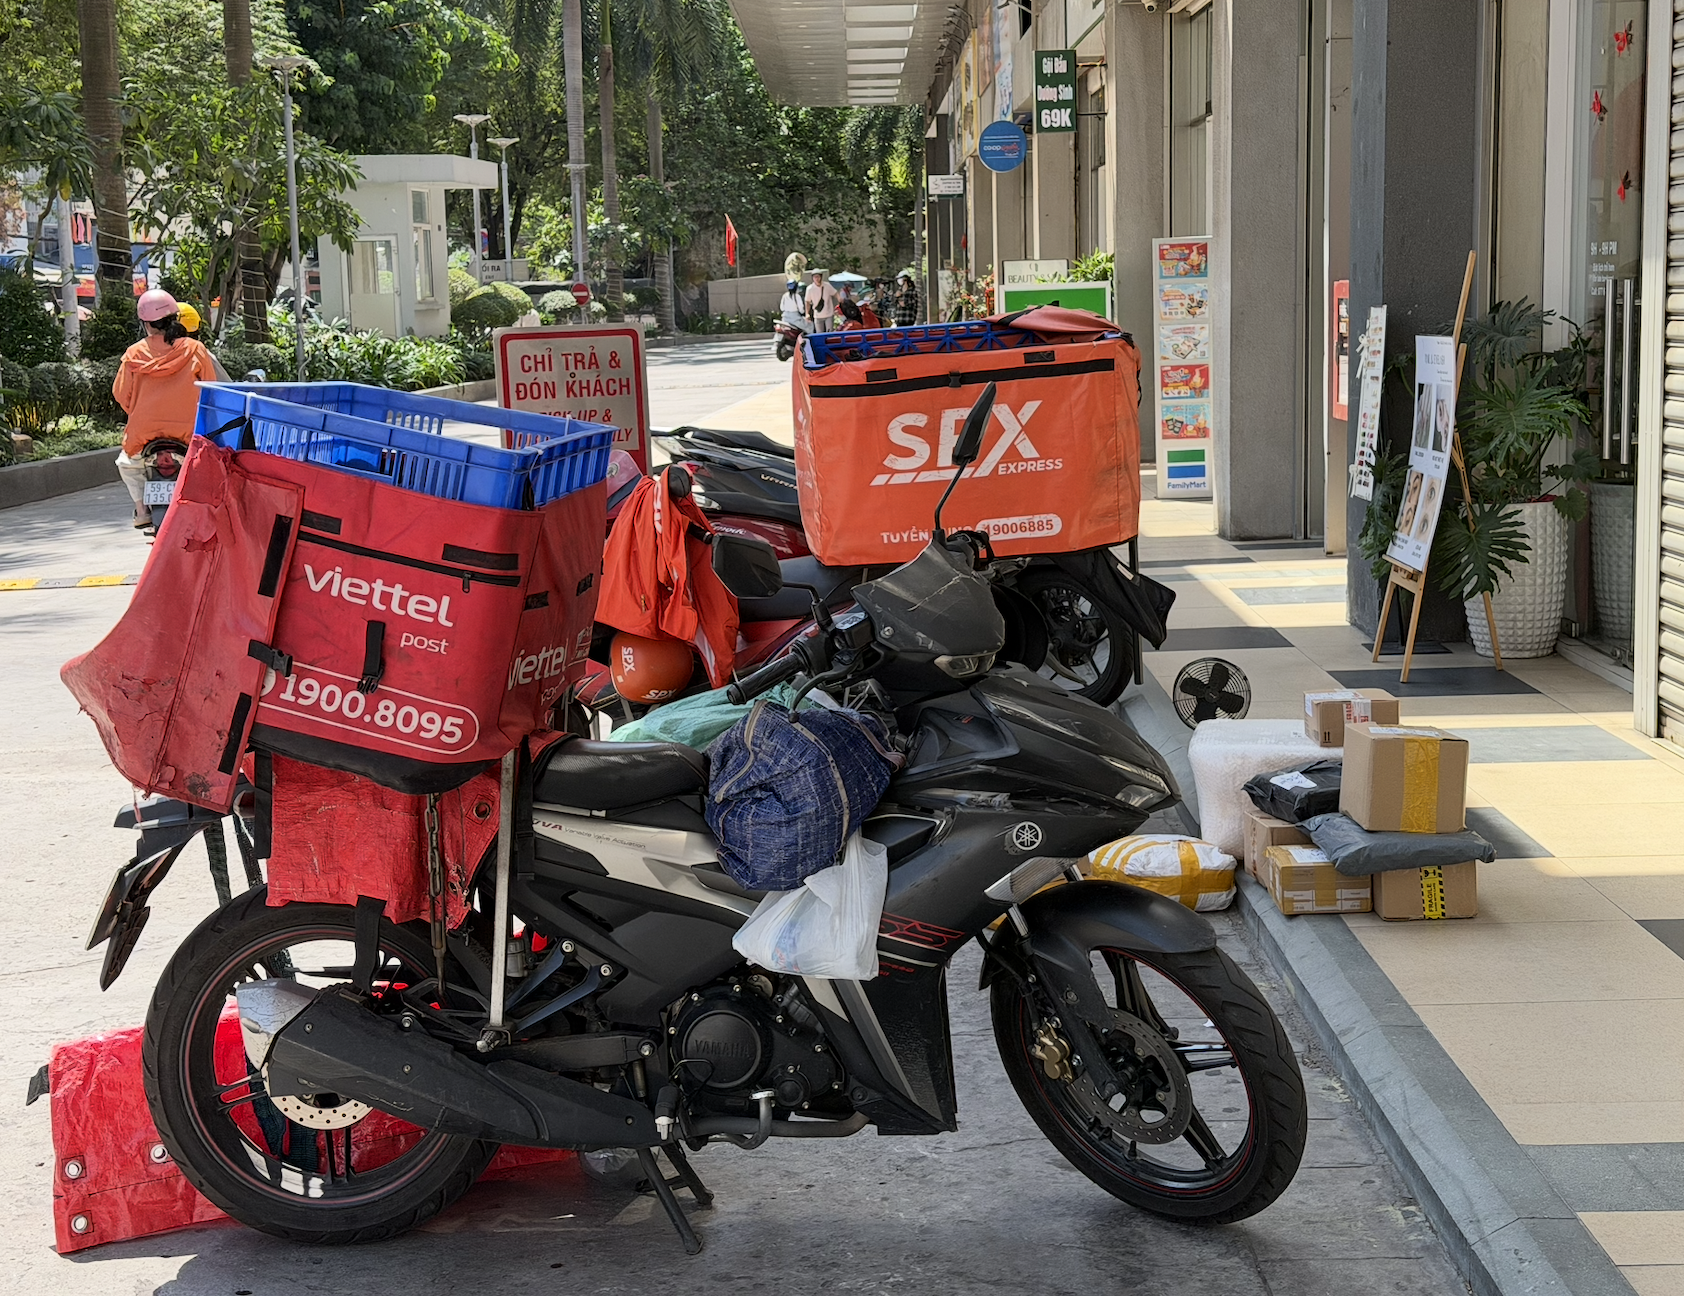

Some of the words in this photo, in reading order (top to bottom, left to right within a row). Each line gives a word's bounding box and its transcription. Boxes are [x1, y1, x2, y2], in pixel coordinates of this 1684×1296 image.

[1058, 84, 1074, 100] Sinh
[1041, 108, 1072, 128] 69K
[520, 347, 553, 373] CHỈ
[561, 345, 600, 371] TRẢ
[608, 350, 621, 369] &
[515, 377, 556, 401] ĐÓN
[566, 374, 631, 398] KHÁCH
[602, 408, 612, 423] &
[998, 458, 1063, 476] EXPRESS
[1167, 481, 1206, 489] FamilyMart
[985, 519, 1053, 536] 19006885
[303, 564, 453, 627] viettel
[400, 631, 449, 655] post
[507, 637, 568, 691] viettel
[622, 645, 636, 676] SPX
[646, 689, 677, 700] SPX
[279, 674, 464, 744] 1900.8095
[565, 827, 592, 838] Variable
[594, 832, 611, 842] Valve
[612, 838, 646, 849] Actuation
[1426, 883, 1434, 912] FRAGILE
[694, 1039, 750, 1058] YAMAHA
